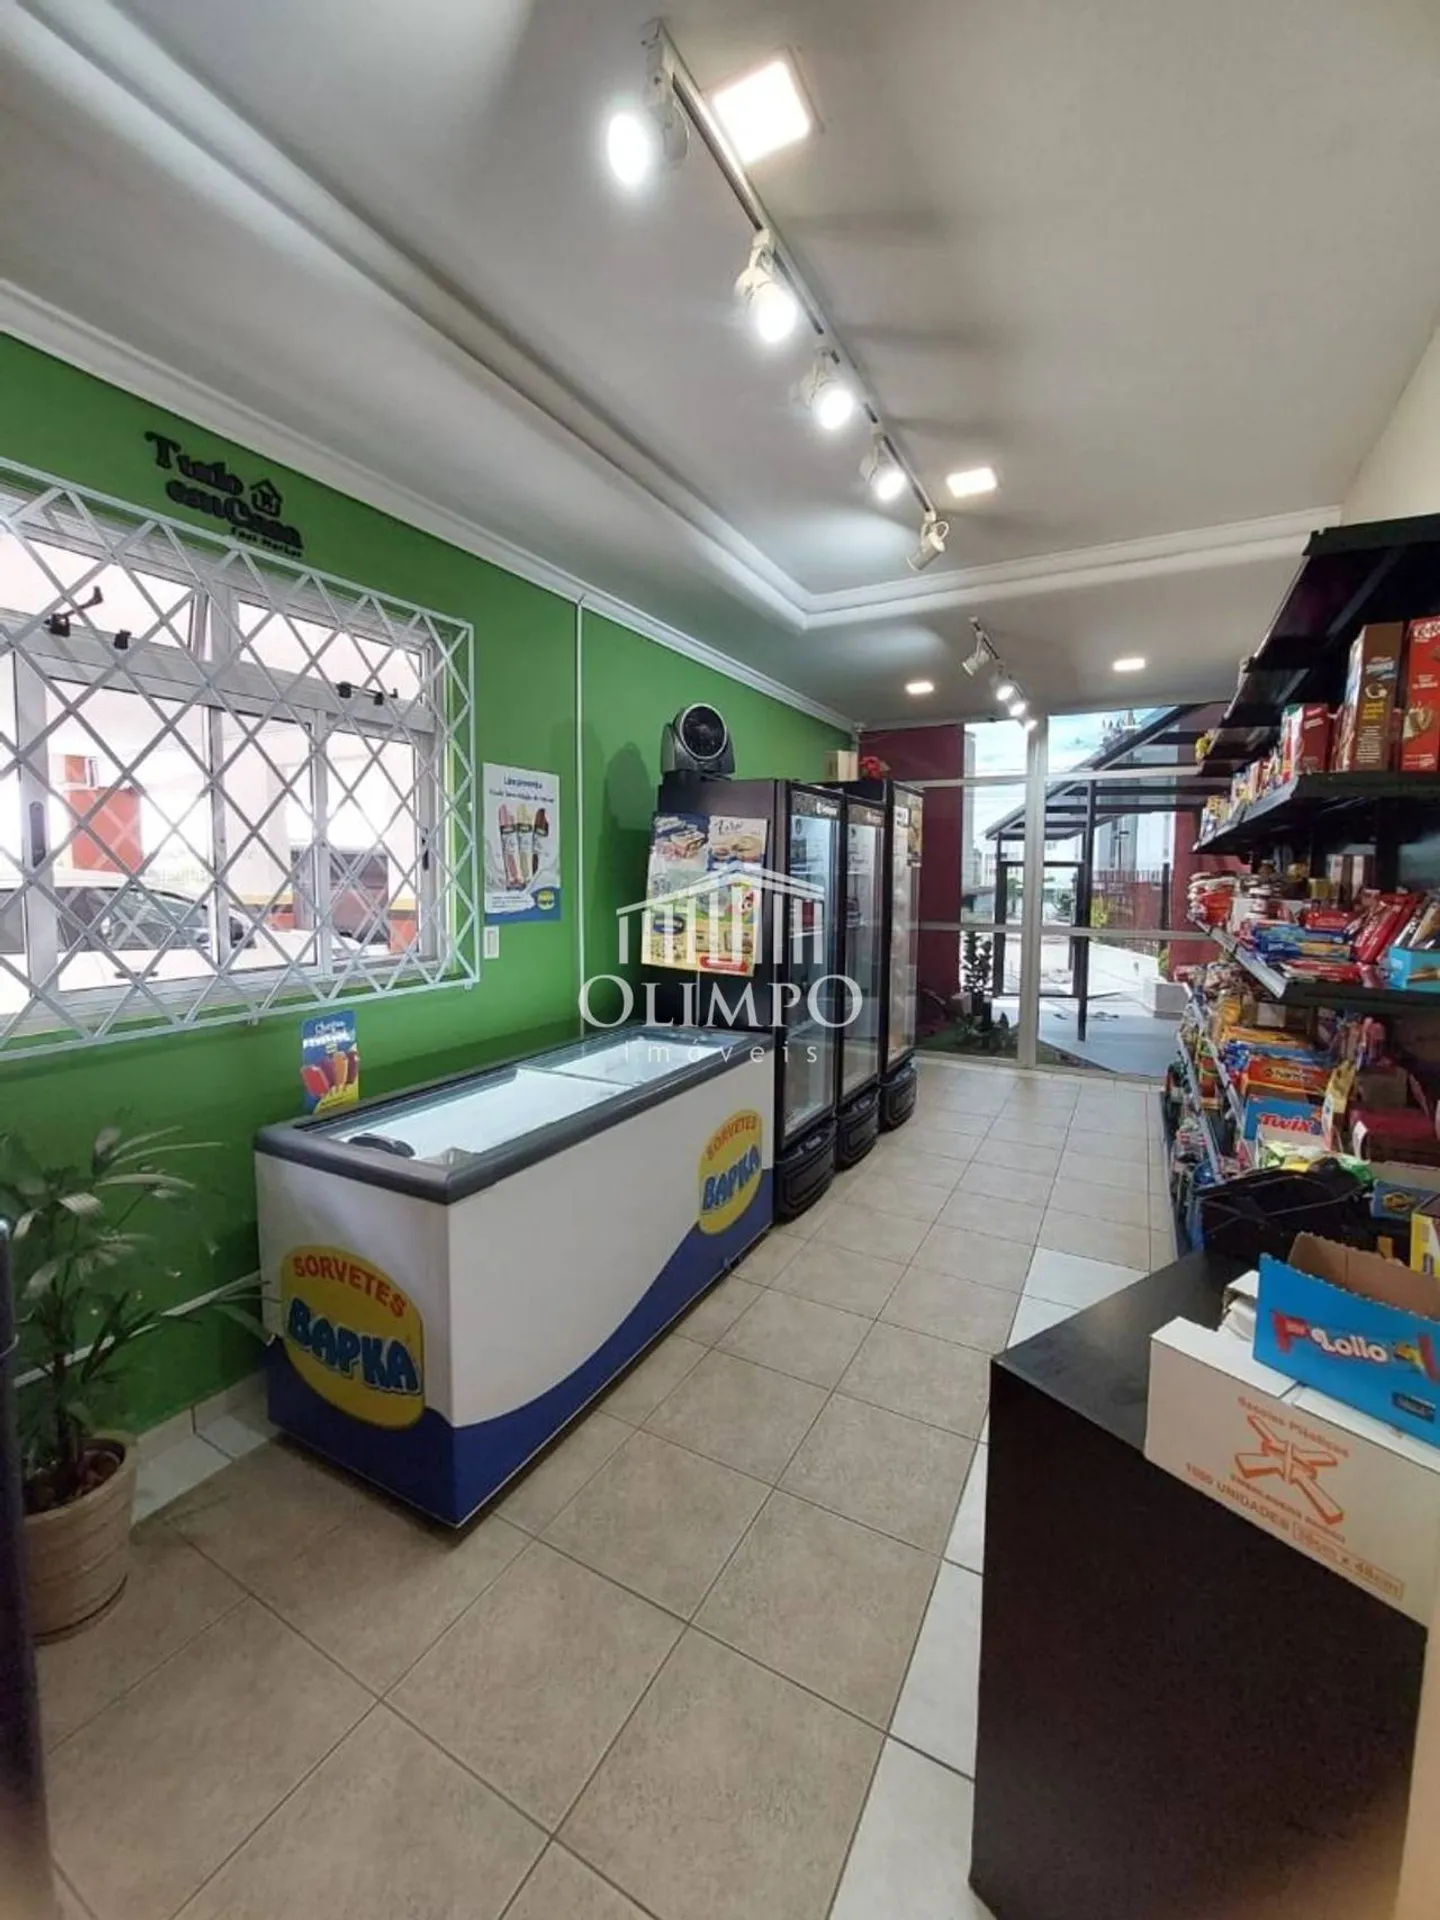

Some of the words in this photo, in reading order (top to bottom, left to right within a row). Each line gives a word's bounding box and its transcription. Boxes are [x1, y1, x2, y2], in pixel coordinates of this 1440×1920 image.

[144, 431, 244, 495] Tudo
[293, 1254, 406, 1318] SORVETES
[287, 1297, 421, 1393] BAPKA
[1310, 1327, 1389, 1364] Lollo
[1216, 1481, 1289, 1531] UNIDADES
